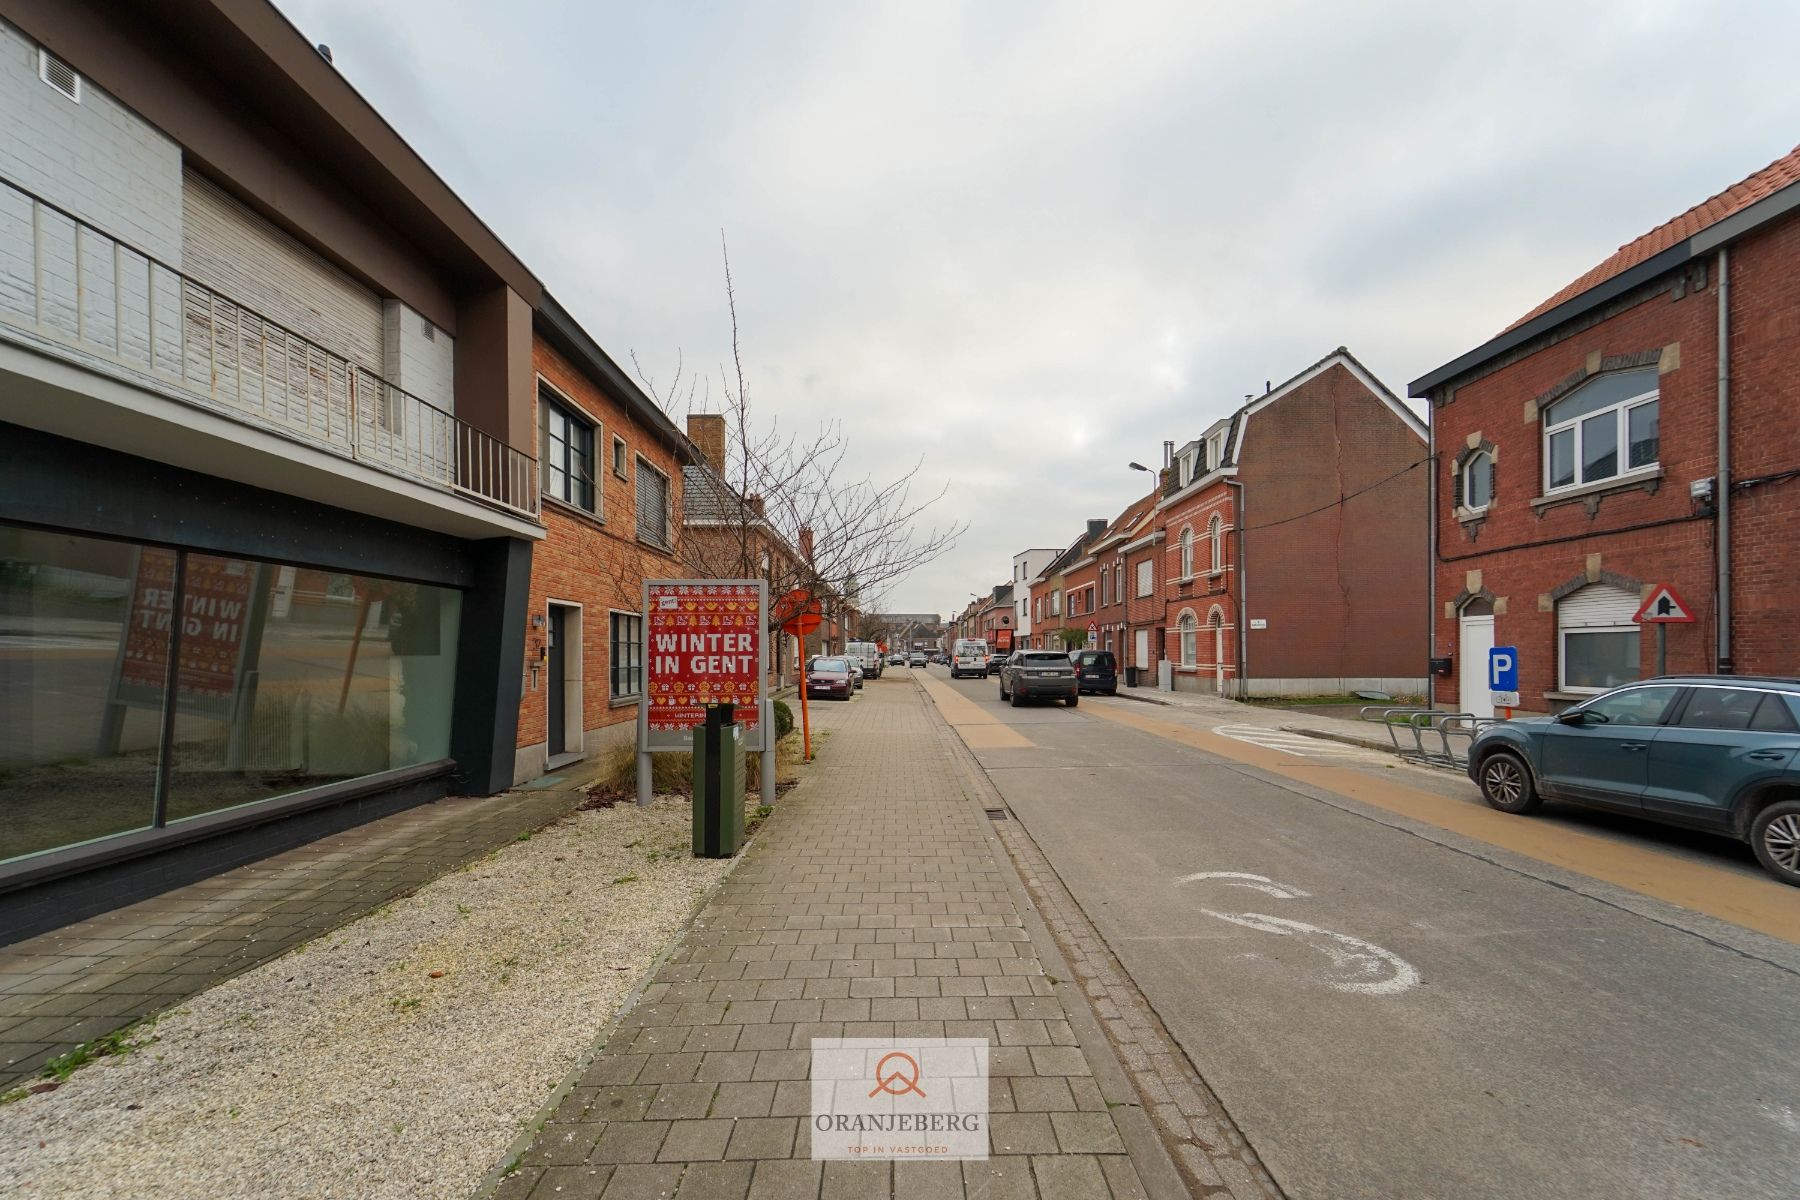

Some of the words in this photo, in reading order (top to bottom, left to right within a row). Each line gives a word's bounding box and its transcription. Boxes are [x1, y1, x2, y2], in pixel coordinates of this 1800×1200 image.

[655, 633, 753, 652] WINTER
[655, 655, 679, 674] IN
[690, 655, 753, 674] GENT
[1493, 654, 1511, 684] P
